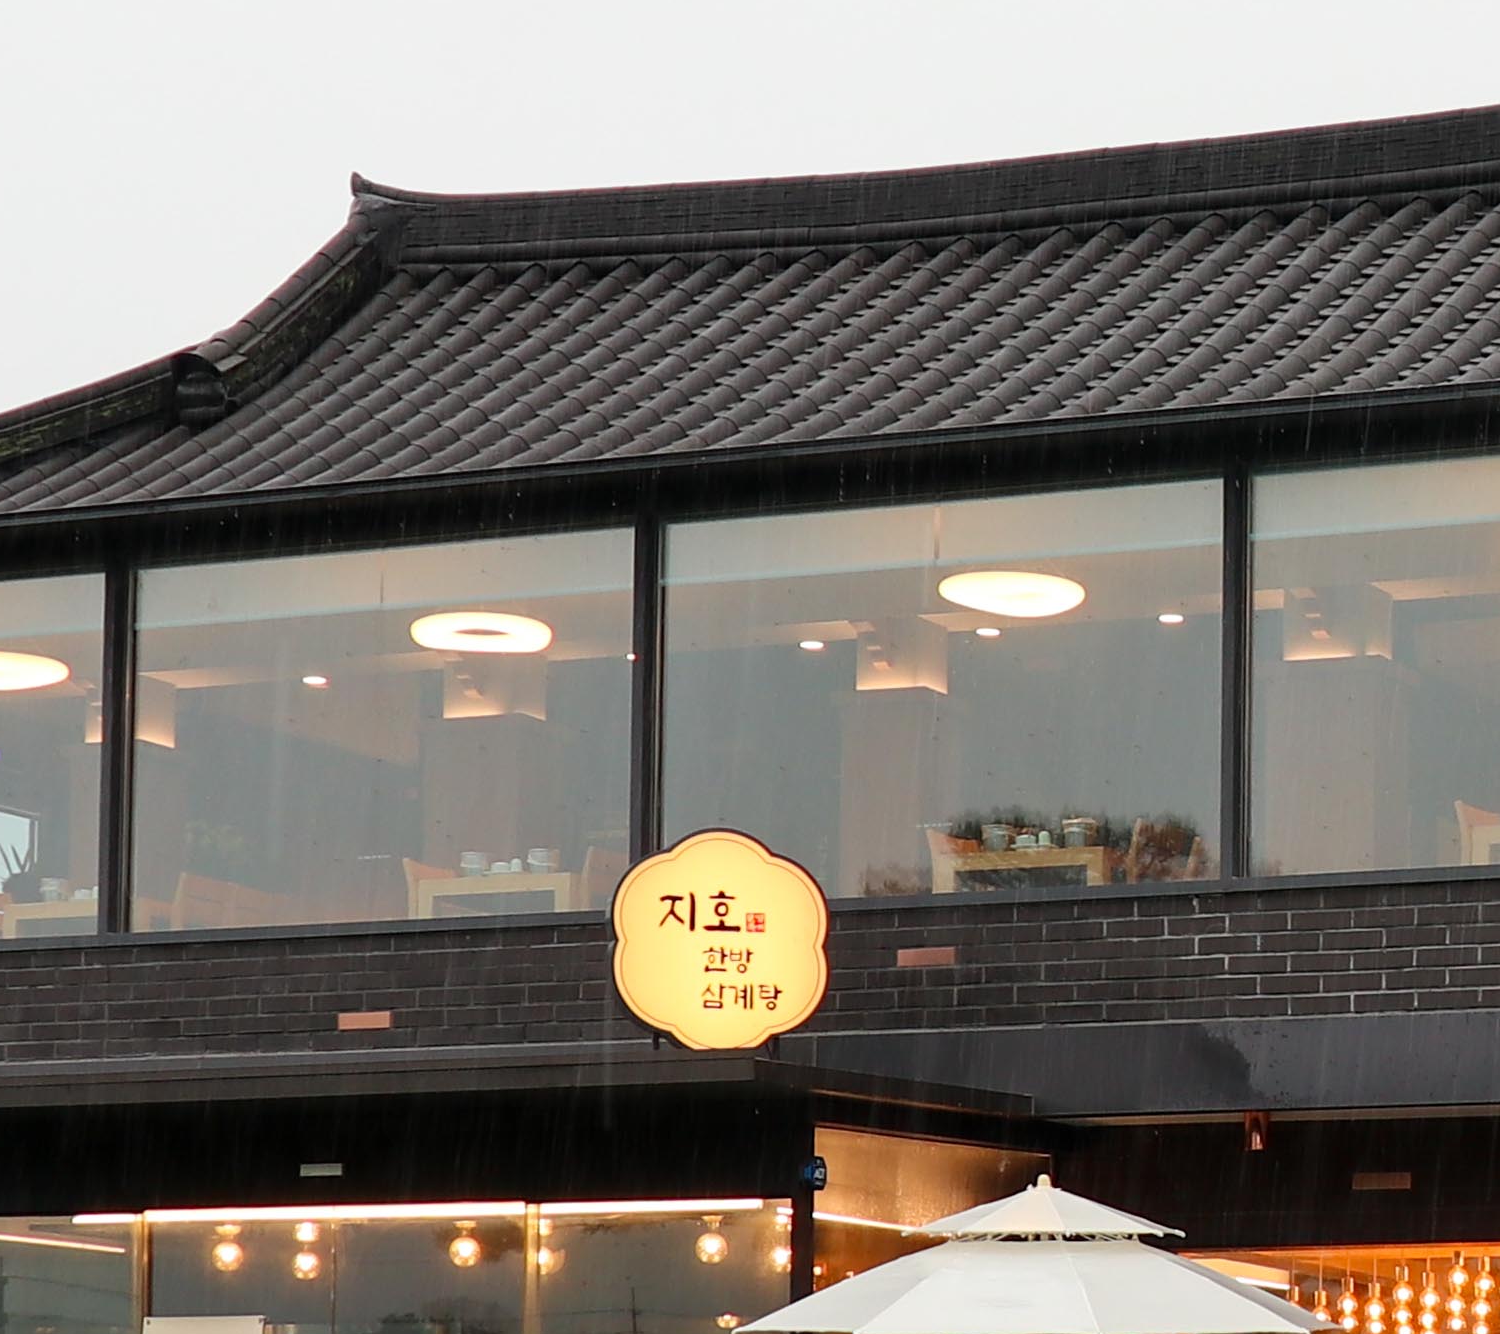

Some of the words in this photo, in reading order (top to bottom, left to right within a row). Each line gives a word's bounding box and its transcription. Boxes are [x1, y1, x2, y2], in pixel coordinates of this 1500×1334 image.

[659, 890, 741, 932] 지호
[702, 946, 754, 974] 한방
[701, 983, 783, 1010] 삼계탕
